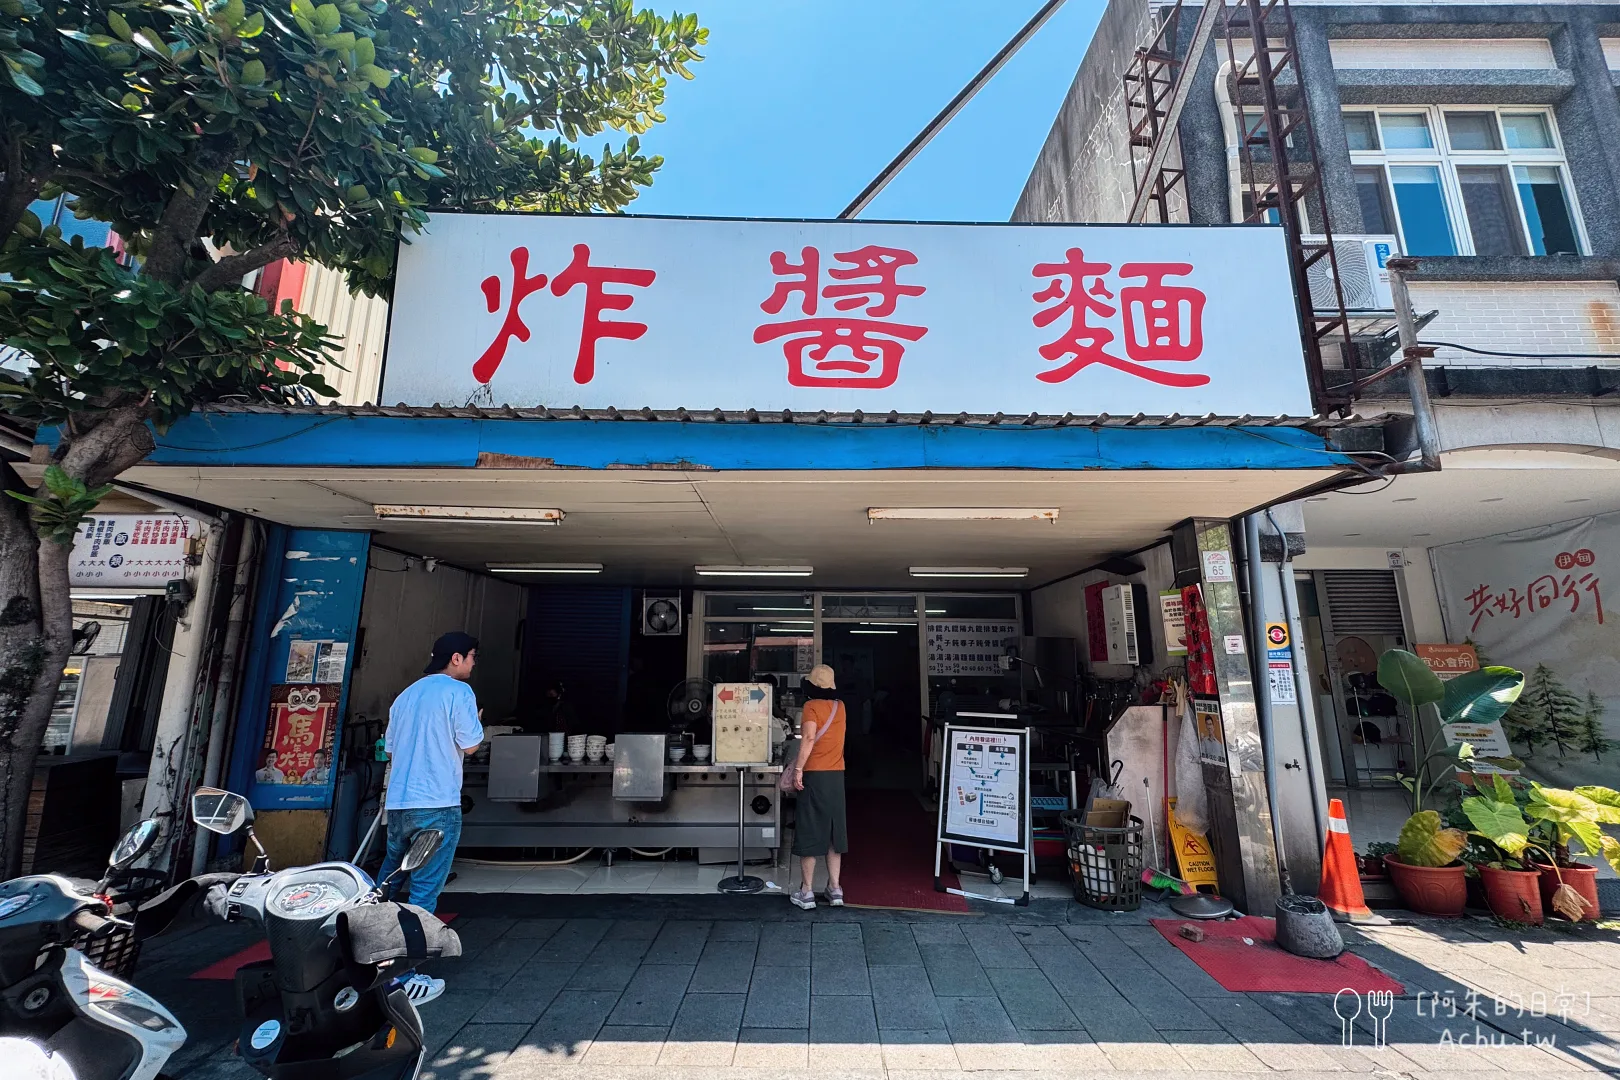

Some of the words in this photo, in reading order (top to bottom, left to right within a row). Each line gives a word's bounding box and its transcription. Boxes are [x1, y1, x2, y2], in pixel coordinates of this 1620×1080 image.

[472, 244, 1211, 389] 炸醬麵
[1212, 565, 1224, 575] 65
[1557, 552, 1592, 568] 伊甸
[1464, 572, 1603, 633] 共好同行
